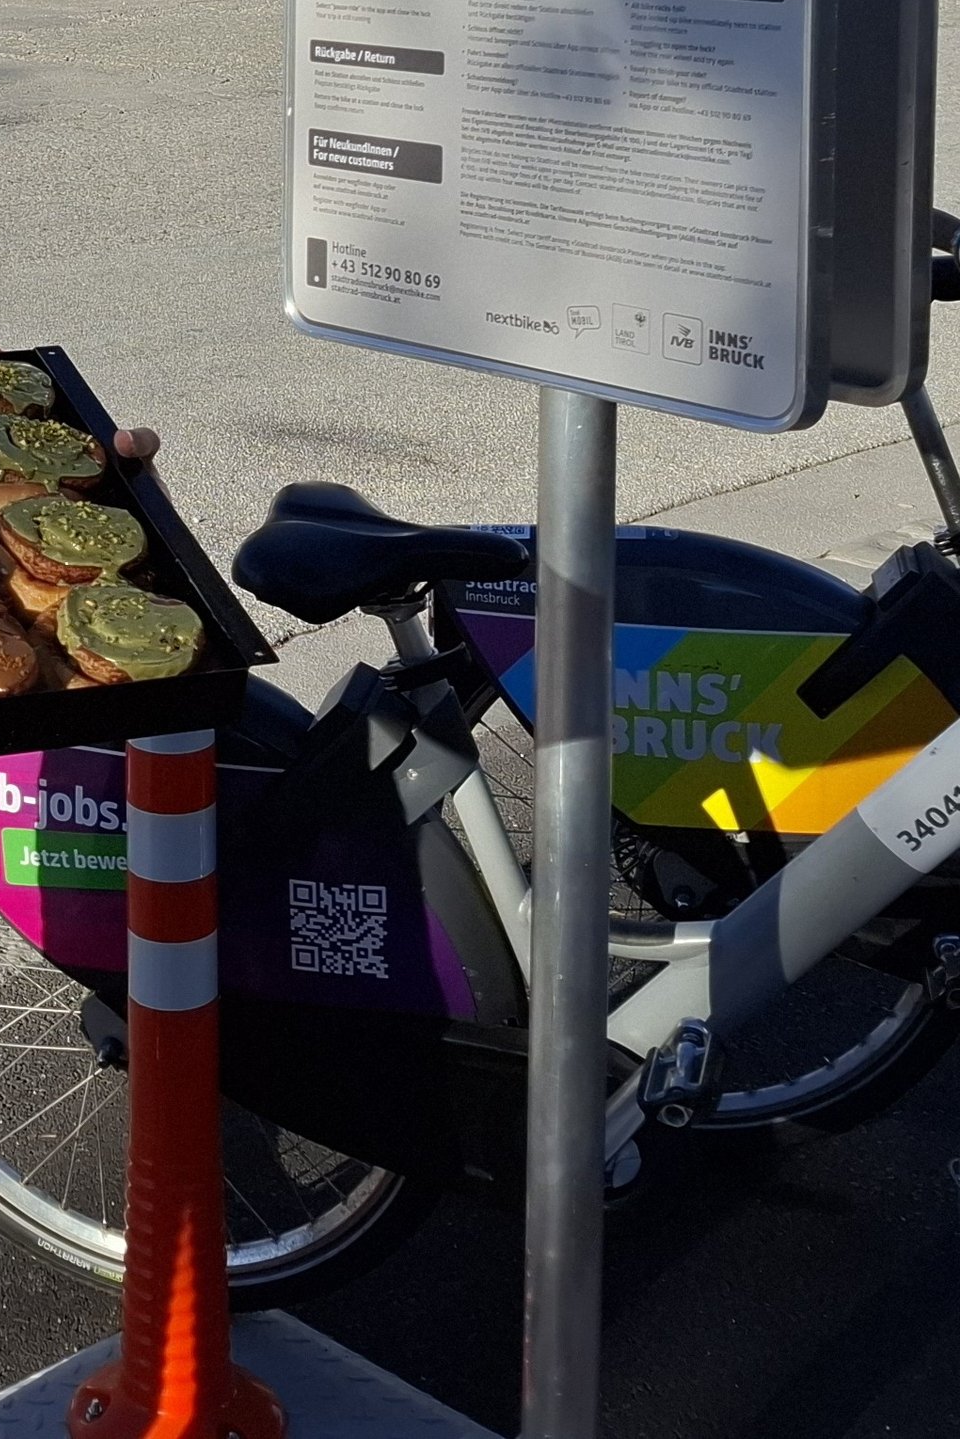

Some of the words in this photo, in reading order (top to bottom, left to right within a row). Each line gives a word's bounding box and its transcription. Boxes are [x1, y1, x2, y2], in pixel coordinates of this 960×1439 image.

[314, 46, 356, 62] Rückgabe
[364, 51, 395, 64] Return
[313, 135, 328, 148] Für
[313, 149, 328, 160] For
[329, 153, 347, 163] new
[348, 155, 394, 170] customers
[332, 240, 367, 258] Hotline
[340, 258, 355, 273] 43
[361, 261, 382, 278] 512
[384, 266, 401, 282] 90
[404, 270, 421, 286] 80
[425, 274, 440, 289] 69
[485, 311, 541, 332] nextbike
[615, 328, 636, 339] LAND
[615, 337, 636, 348] TIROL
[670, 335, 695, 349] IVB
[708, 328, 753, 350] INNS'
[708, 348, 765, 370] BRUCK
[465, 590, 521, 606] Innsbruck
[612, 713, 783, 763] BRUCK
[20, 846, 70, 868] Jetzt
[37, 1238, 91, 1271] MARATHON
